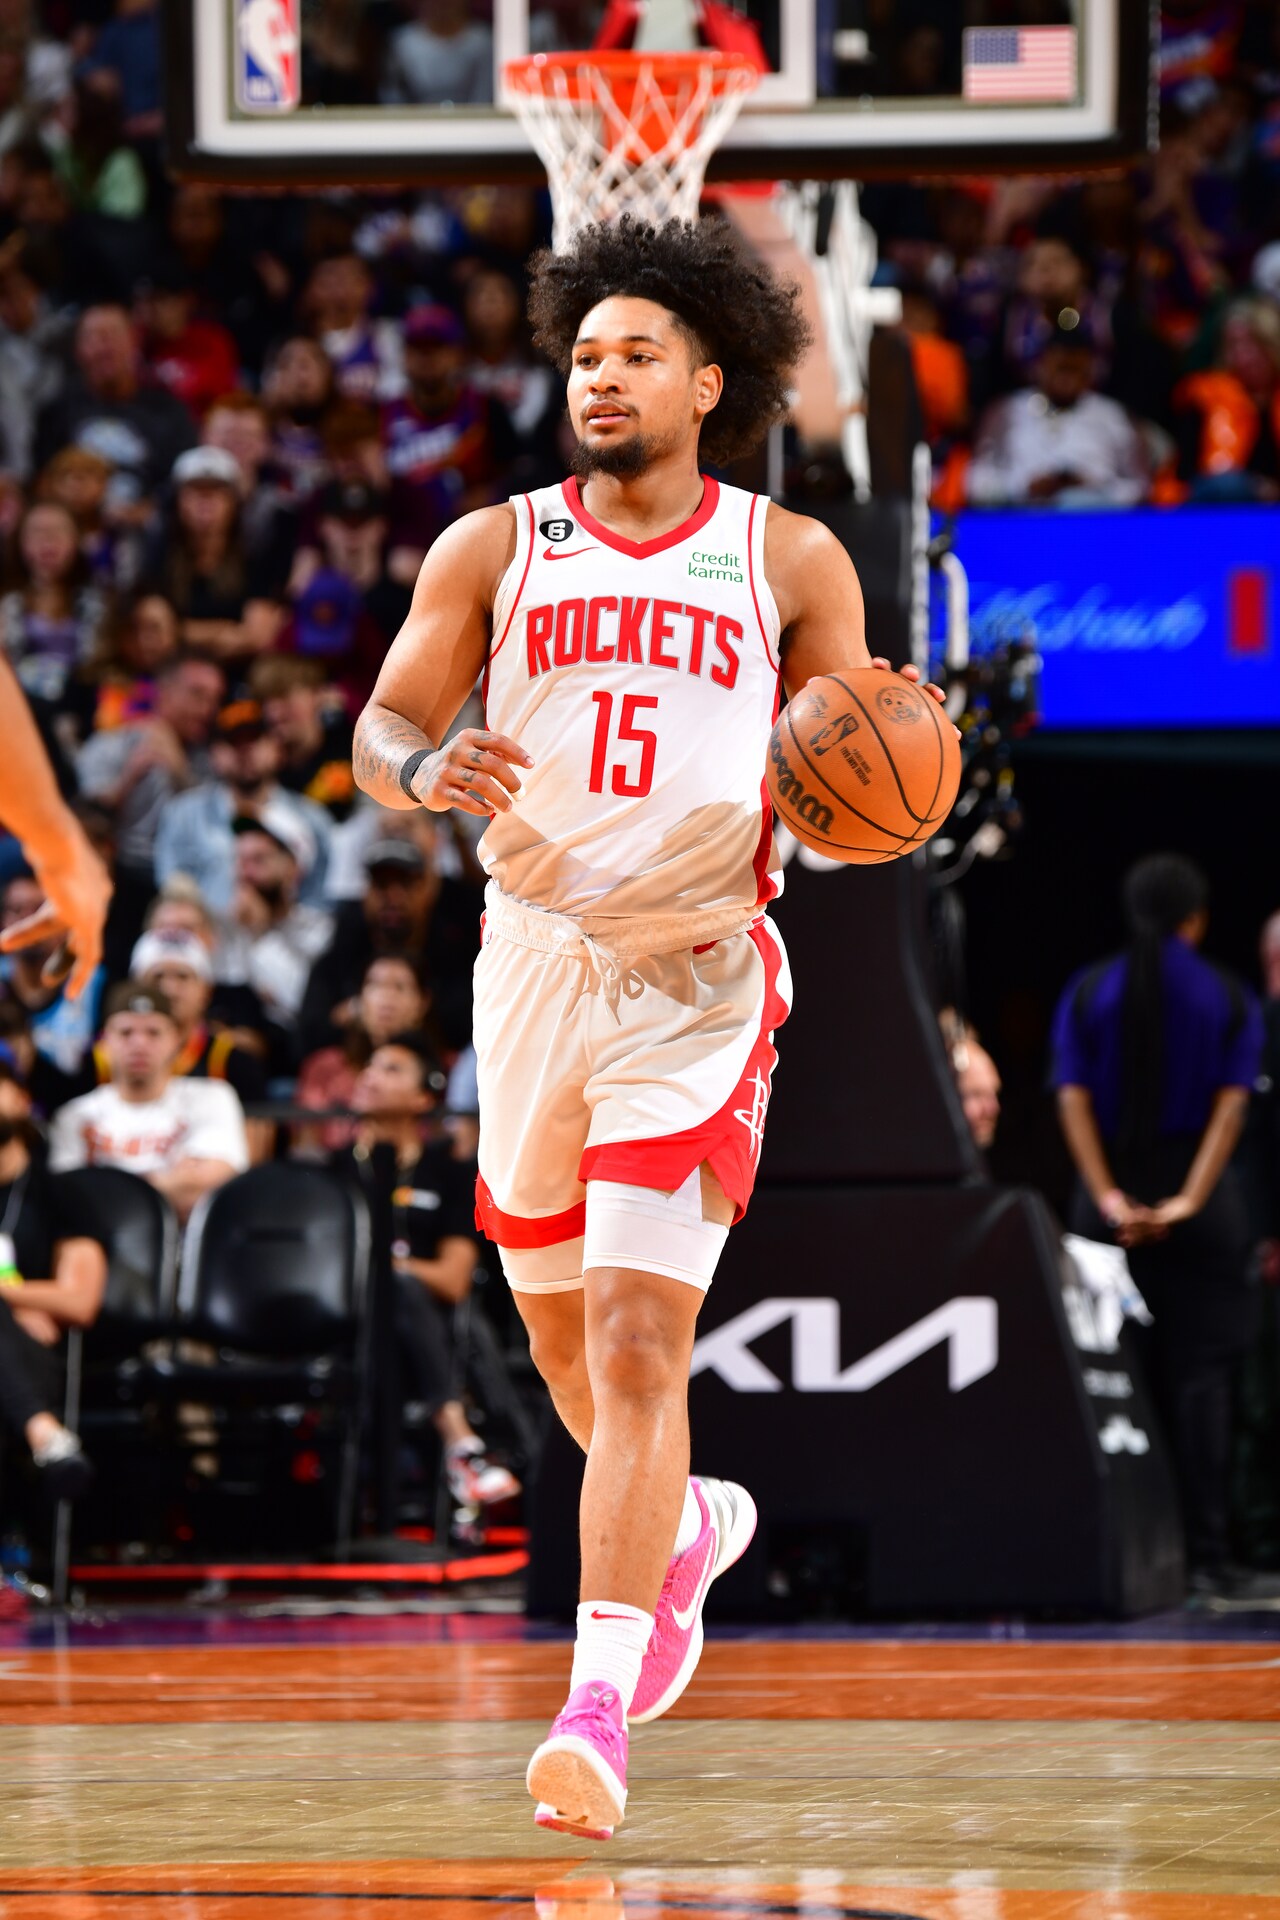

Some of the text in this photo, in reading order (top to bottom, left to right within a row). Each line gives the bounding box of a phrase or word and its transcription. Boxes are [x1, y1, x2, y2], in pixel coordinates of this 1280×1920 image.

[547, 521, 566, 540] 6
[688, 562, 743, 583] karma
[526, 596, 744, 691] ROCKETS
[588, 690, 659, 797] 15
